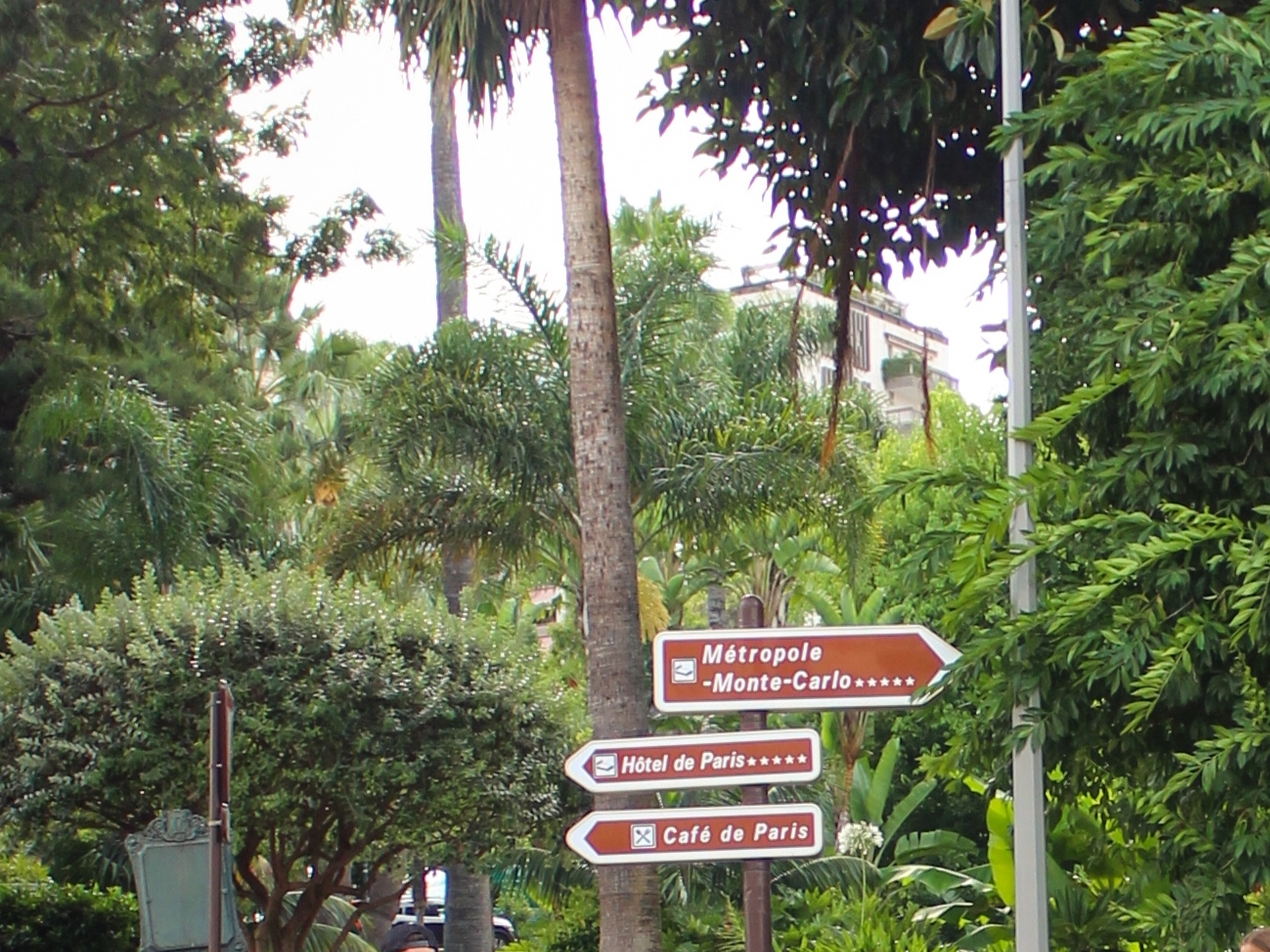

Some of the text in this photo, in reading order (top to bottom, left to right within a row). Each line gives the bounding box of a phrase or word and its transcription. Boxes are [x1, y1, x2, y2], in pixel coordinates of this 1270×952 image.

[702, 642, 823, 667] Métropole
[703, 670, 852, 693] -Monte-Carlo
[621, 751, 745, 774] Hôtel de Paris
[663, 822, 809, 845] Café de Paris
